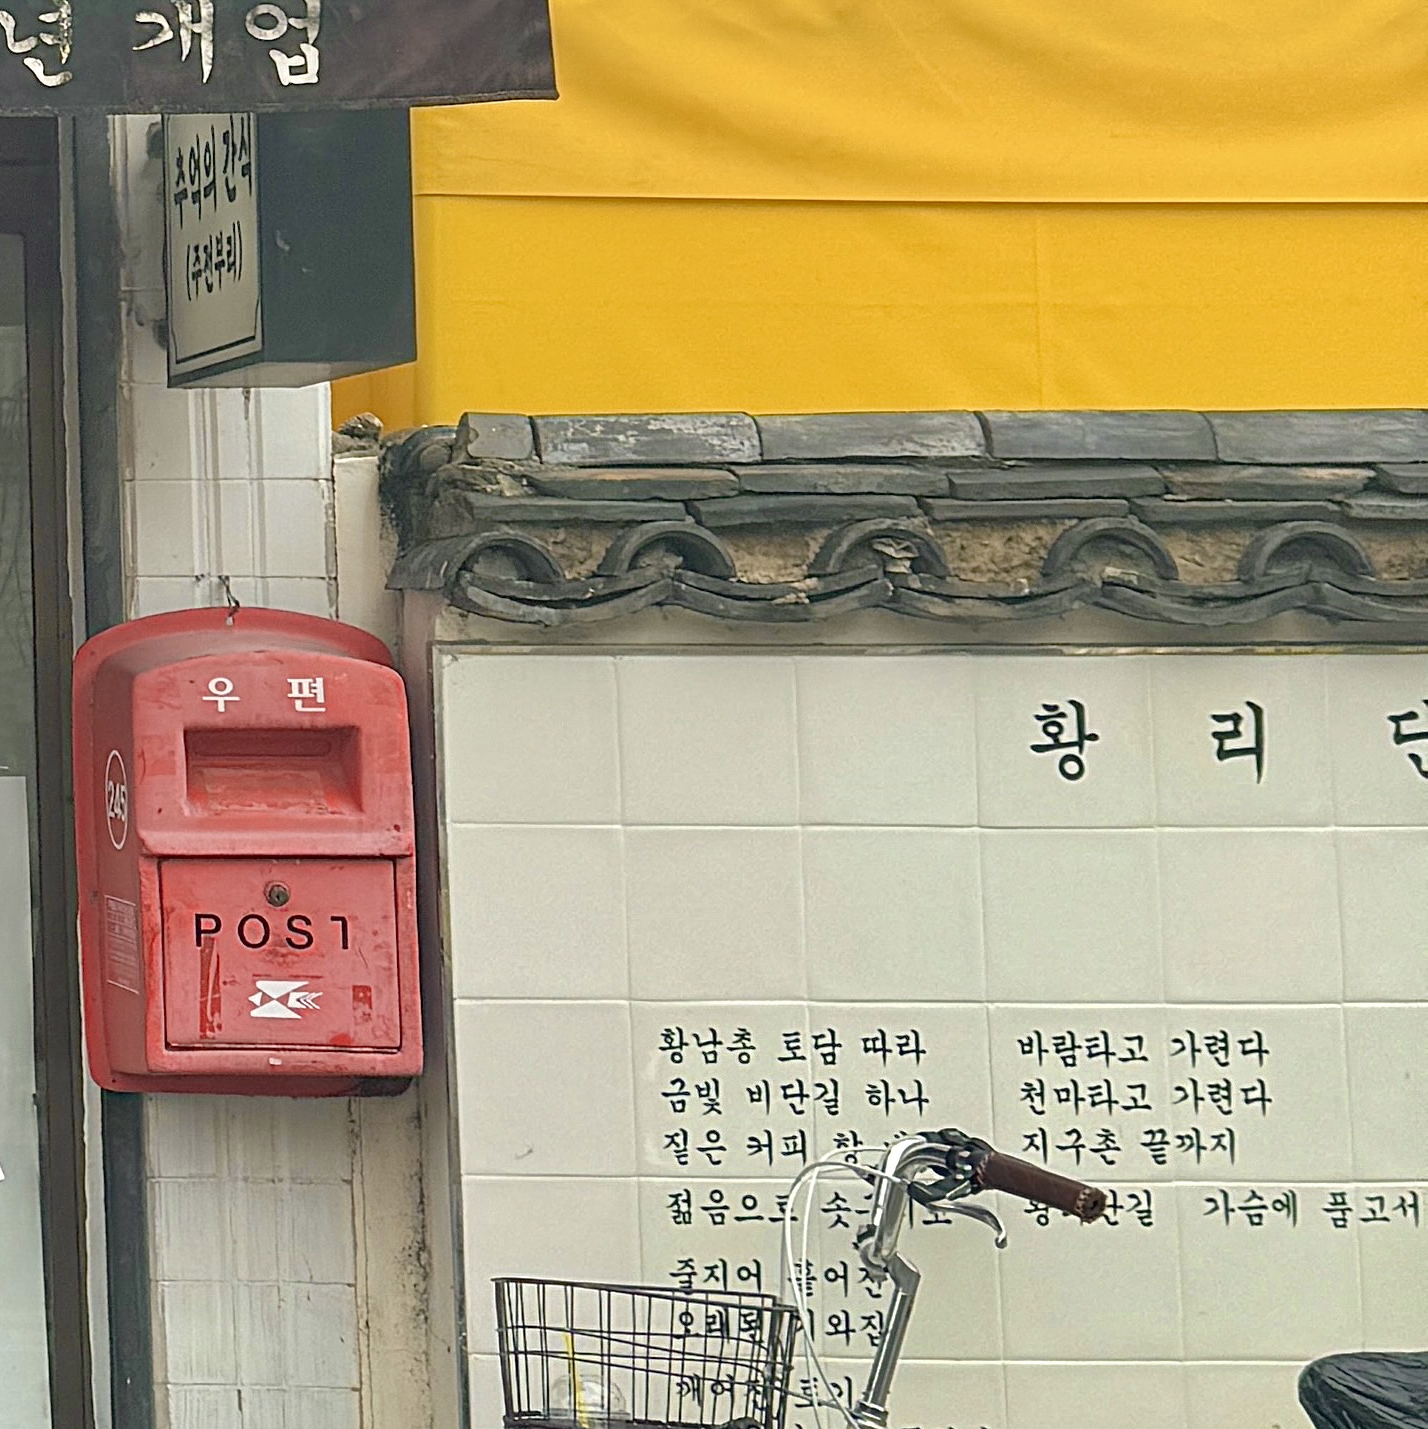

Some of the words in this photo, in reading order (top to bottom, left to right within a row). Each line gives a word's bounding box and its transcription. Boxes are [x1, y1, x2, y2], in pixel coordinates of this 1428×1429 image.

[173, 124, 217, 229] 추억의
[222, 116, 253, 204] 간식
[195, 913, 353, 951] POST
[658, 1026, 757, 1065] 황남총
[776, 1028, 843, 1066] 토담
[861, 1028, 927, 1067] 따라
[1017, 1030, 1150, 1068] 바람타고
[1170, 1030, 1270, 1068] 가련다
[661, 1077, 723, 1116] 금빛
[746, 1077, 841, 1116] 비단길
[865, 1078, 930, 1117] 하나
[1019, 1077, 1153, 1117] 천마타고
[1172, 1077, 1273, 1117] 가련다
[746, 1129, 809, 1167] 커피
[1021, 1126, 1122, 1166] 지구촌
[1139, 1126, 1236, 1166] 끝까지
[1202, 1188, 1299, 1228] 가슴에
[1321, 1189, 1422, 1229] 품고서
[668, 1257, 762, 1295] 줄지어
